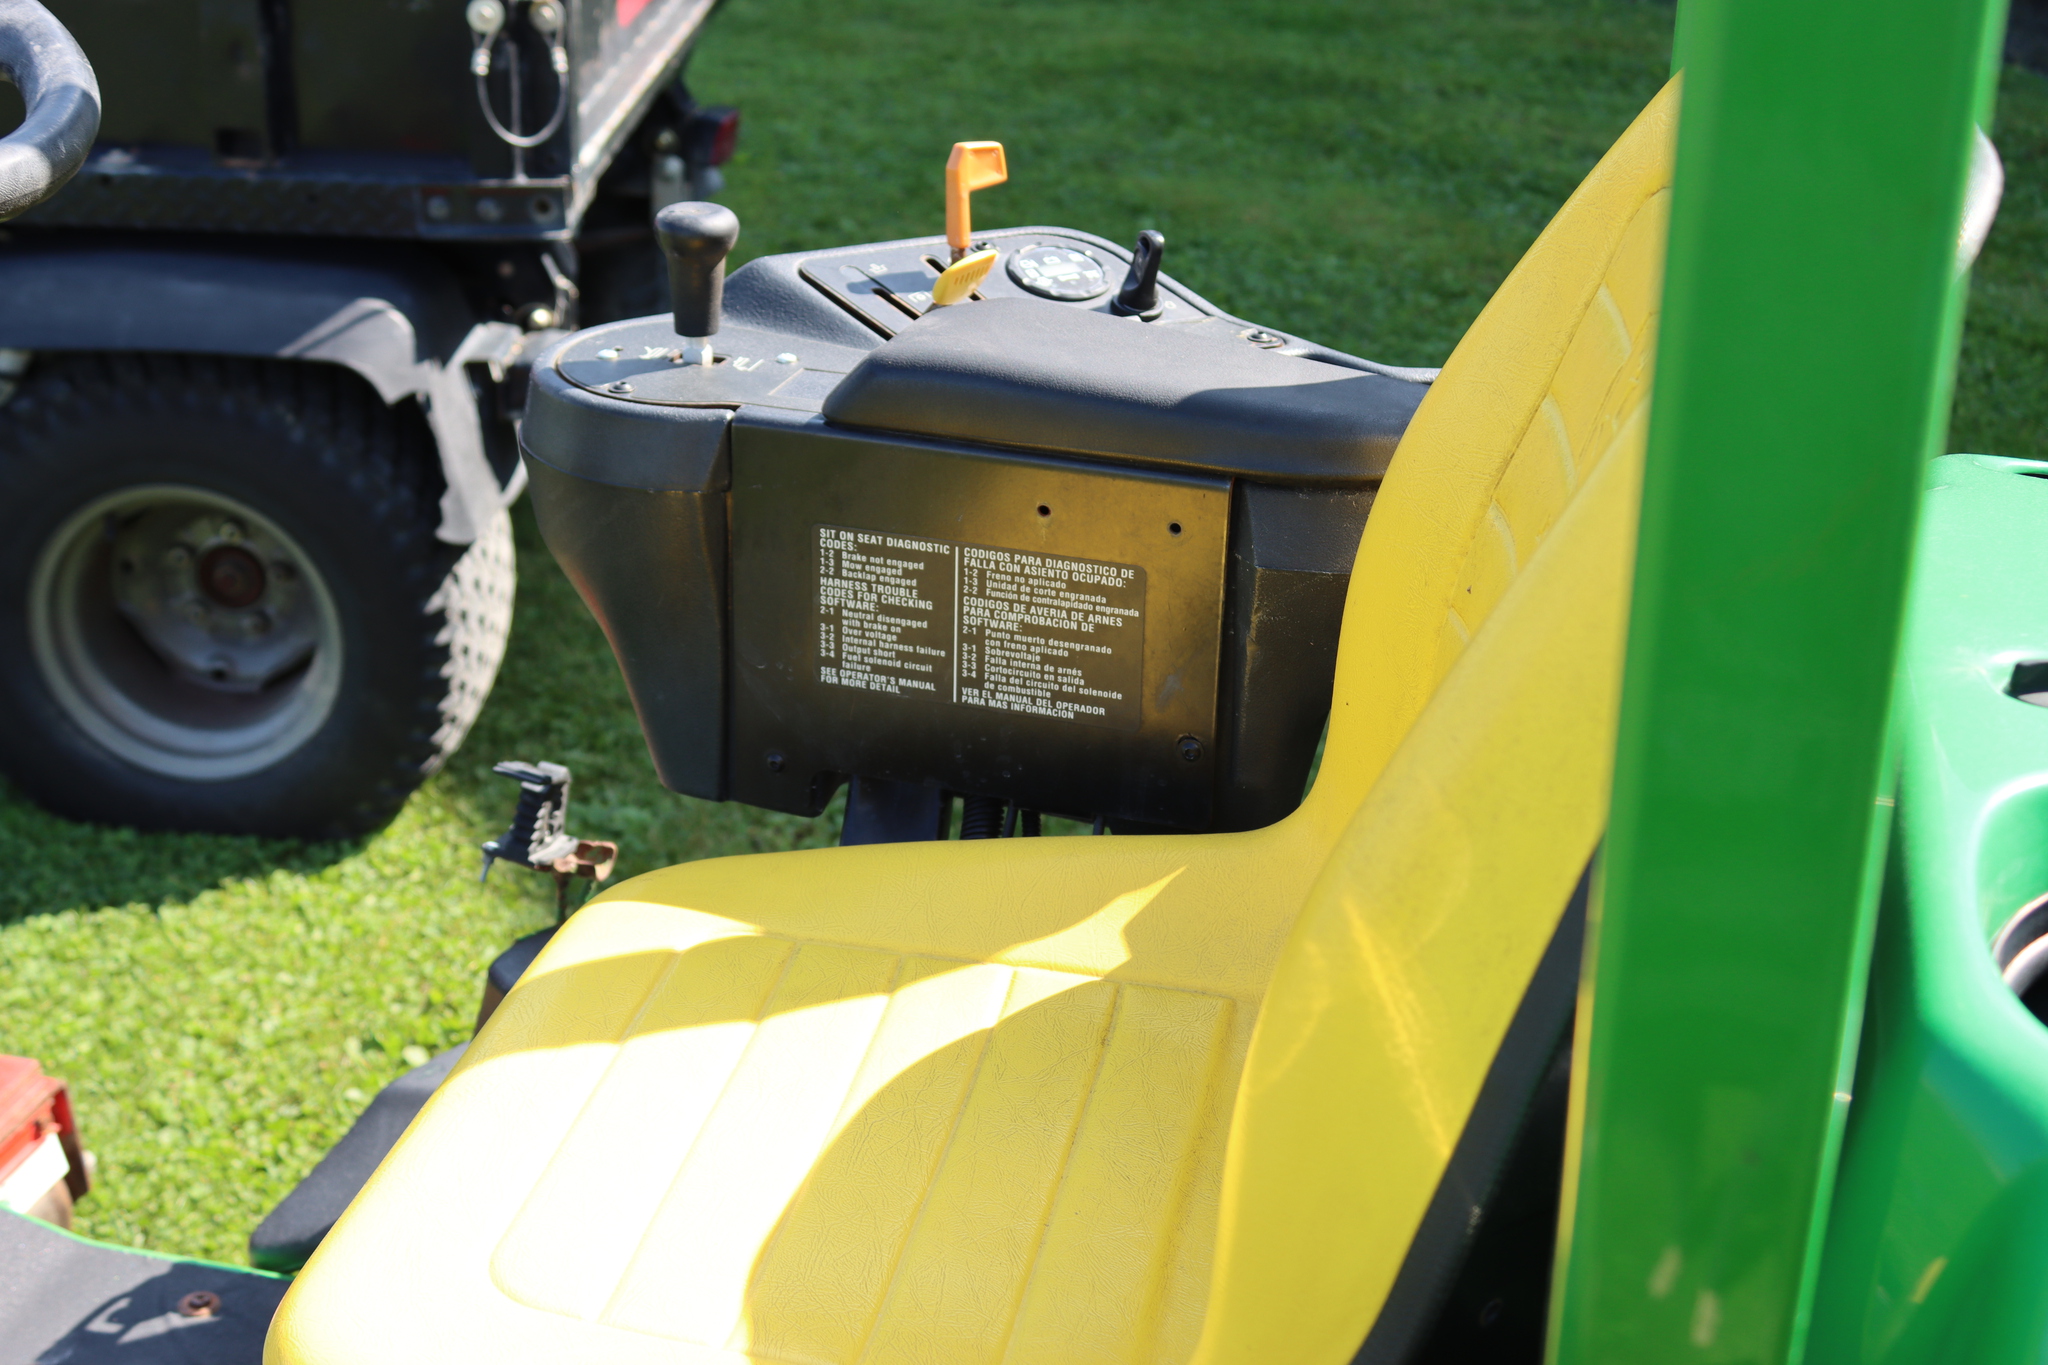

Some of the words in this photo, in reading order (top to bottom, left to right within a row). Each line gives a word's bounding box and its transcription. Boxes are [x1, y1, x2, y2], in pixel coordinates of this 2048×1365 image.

[820, 528, 836, 538] SIT
[840, 531, 854, 541] ON
[858, 533, 883, 545] SEAT
[887, 537, 950, 554] DIAGNOSTIC
[820, 538, 857, 551] CODES:
[820, 549, 834, 557] 1-2
[842, 551, 866, 562] Brake
[870, 556, 884, 564] not
[887, 558, 924, 570] engaged
[820, 558, 834, 566] 1-3
[842, 560, 862, 569] Mow
[865, 563, 902, 576] engaged
[964, 548, 1010, 562] CODIGOS
[1014, 554, 1042, 566] PARA
[1046, 559, 1117, 576] DIAGNOSTICO
[1121, 569, 1134, 579] DE
[820, 566, 834, 575] 2-2
[842, 569, 876, 581] Backlap
[879, 576, 917, 586] engaged
[964, 558, 996, 570] FALLA
[1000, 562, 1021, 573] CON
[1024, 566, 1068, 580] ASIENTO
[1072, 572, 1126, 588] OCUPADO:
[964, 568, 978, 577] 1-2
[986, 571, 1011, 581] Freno
[1028, 577, 1066, 589] aplicado
[820, 577, 867, 591] HARNESS
[871, 584, 918, 598] TROUBLE
[820, 586, 854, 599] CODES
[858, 591, 878, 602] FOR
[881, 595, 933, 610] CHECKING
[964, 577, 978, 586] 1-3
[986, 580, 1016, 591] Unidad
[1020, 583, 1031, 593] de
[1034, 587, 1056, 596] corte
[1059, 590, 1106, 603] engranada
[820, 596, 879, 612] SOFTWARE:
[963, 586, 978, 594] 2-2
[986, 589, 1017, 600] Función
[1020, 592, 1030, 601] de
[1032, 595, 1093, 611] contralapidado
[1096, 604, 1139, 617] engranada
[963, 596, 1010, 611] CODIGOS
[1013, 603, 1026, 613] DE
[1030, 606, 1067, 619] AVERIA
[1071, 612, 1084, 621] DE
[1088, 614, 1123, 627] ARNES
[820, 606, 834, 615] 2-1
[842, 609, 874, 620] Neutral
[877, 614, 927, 628] disengaged
[842, 619, 860, 627] with
[864, 621, 887, 631] brake
[963, 606, 991, 618] PARA
[994, 610, 1078, 630] COMPROBACION
[1081, 622, 1094, 632] DE
[963, 616, 1022, 632] SOFTWARE:
[820, 623, 834, 632] 3-1
[842, 626, 862, 636] Over
[865, 630, 897, 642] voltage
[963, 626, 976, 635] 2-1
[986, 629, 1010, 640] Punto
[1014, 634, 1045, 644] muerto
[1048, 638, 1112, 654] desengranado
[820, 632, 834, 640] 3-2
[842, 635, 876, 646] Internal
[879, 641, 913, 652] harness
[916, 646, 945, 657] failure
[820, 640, 834, 649] 3-3
[842, 644, 870, 654] Output
[873, 648, 895, 658] short
[962, 643, 976, 652] 3-1
[985, 647, 1041, 662] Sobrevoltaje
[985, 639, 1000, 647] con
[1004, 641, 1027, 651] freno
[1030, 644, 1069, 657] aplicado
[820, 649, 835, 658] 3-4
[842, 652, 860, 662] Fuel
[864, 656, 901, 668] solenoid
[904, 662, 932, 672] circuit
[842, 661, 871, 672] failure
[962, 652, 976, 661] 3-2
[985, 655, 1006, 666] Falla
[1010, 659, 1041, 671] interna
[1044, 664, 1054, 673] de
[1058, 666, 1082, 676] arnés
[821, 667, 836, 675] SEE
[840, 669, 895, 685] OPERATOR'S
[899, 678, 936, 691] MANUAL
[821, 675, 838, 684] FOR
[841, 678, 866, 688] MORE
[870, 682, 900, 693] DETAIL
[962, 661, 976, 670] 3-3
[985, 664, 1041, 679] Cortocircuito
[1044, 673, 1054, 681] en
[1058, 675, 1084, 686] salida
[962, 670, 976, 678] 3-4
[985, 673, 1006, 683] Falla
[1010, 676, 1023, 685] del
[1026, 679, 1059, 690] circuito
[1062, 684, 1076, 693] del
[1079, 687, 1122, 700] solenoide
[984, 681, 994, 690] de
[998, 684, 1051, 698] combustible
[962, 687, 979, 696] VER
[982, 690, 992, 698] EL
[996, 692, 1033, 705] MANUAL
[1036, 698, 1052, 708] DEL
[1056, 702, 1105, 716] OPERADOR
[962, 695, 986, 706] PARA
[988, 699, 1008, 710] MAS
[1011, 702, 1074, 719] INFORMACION
